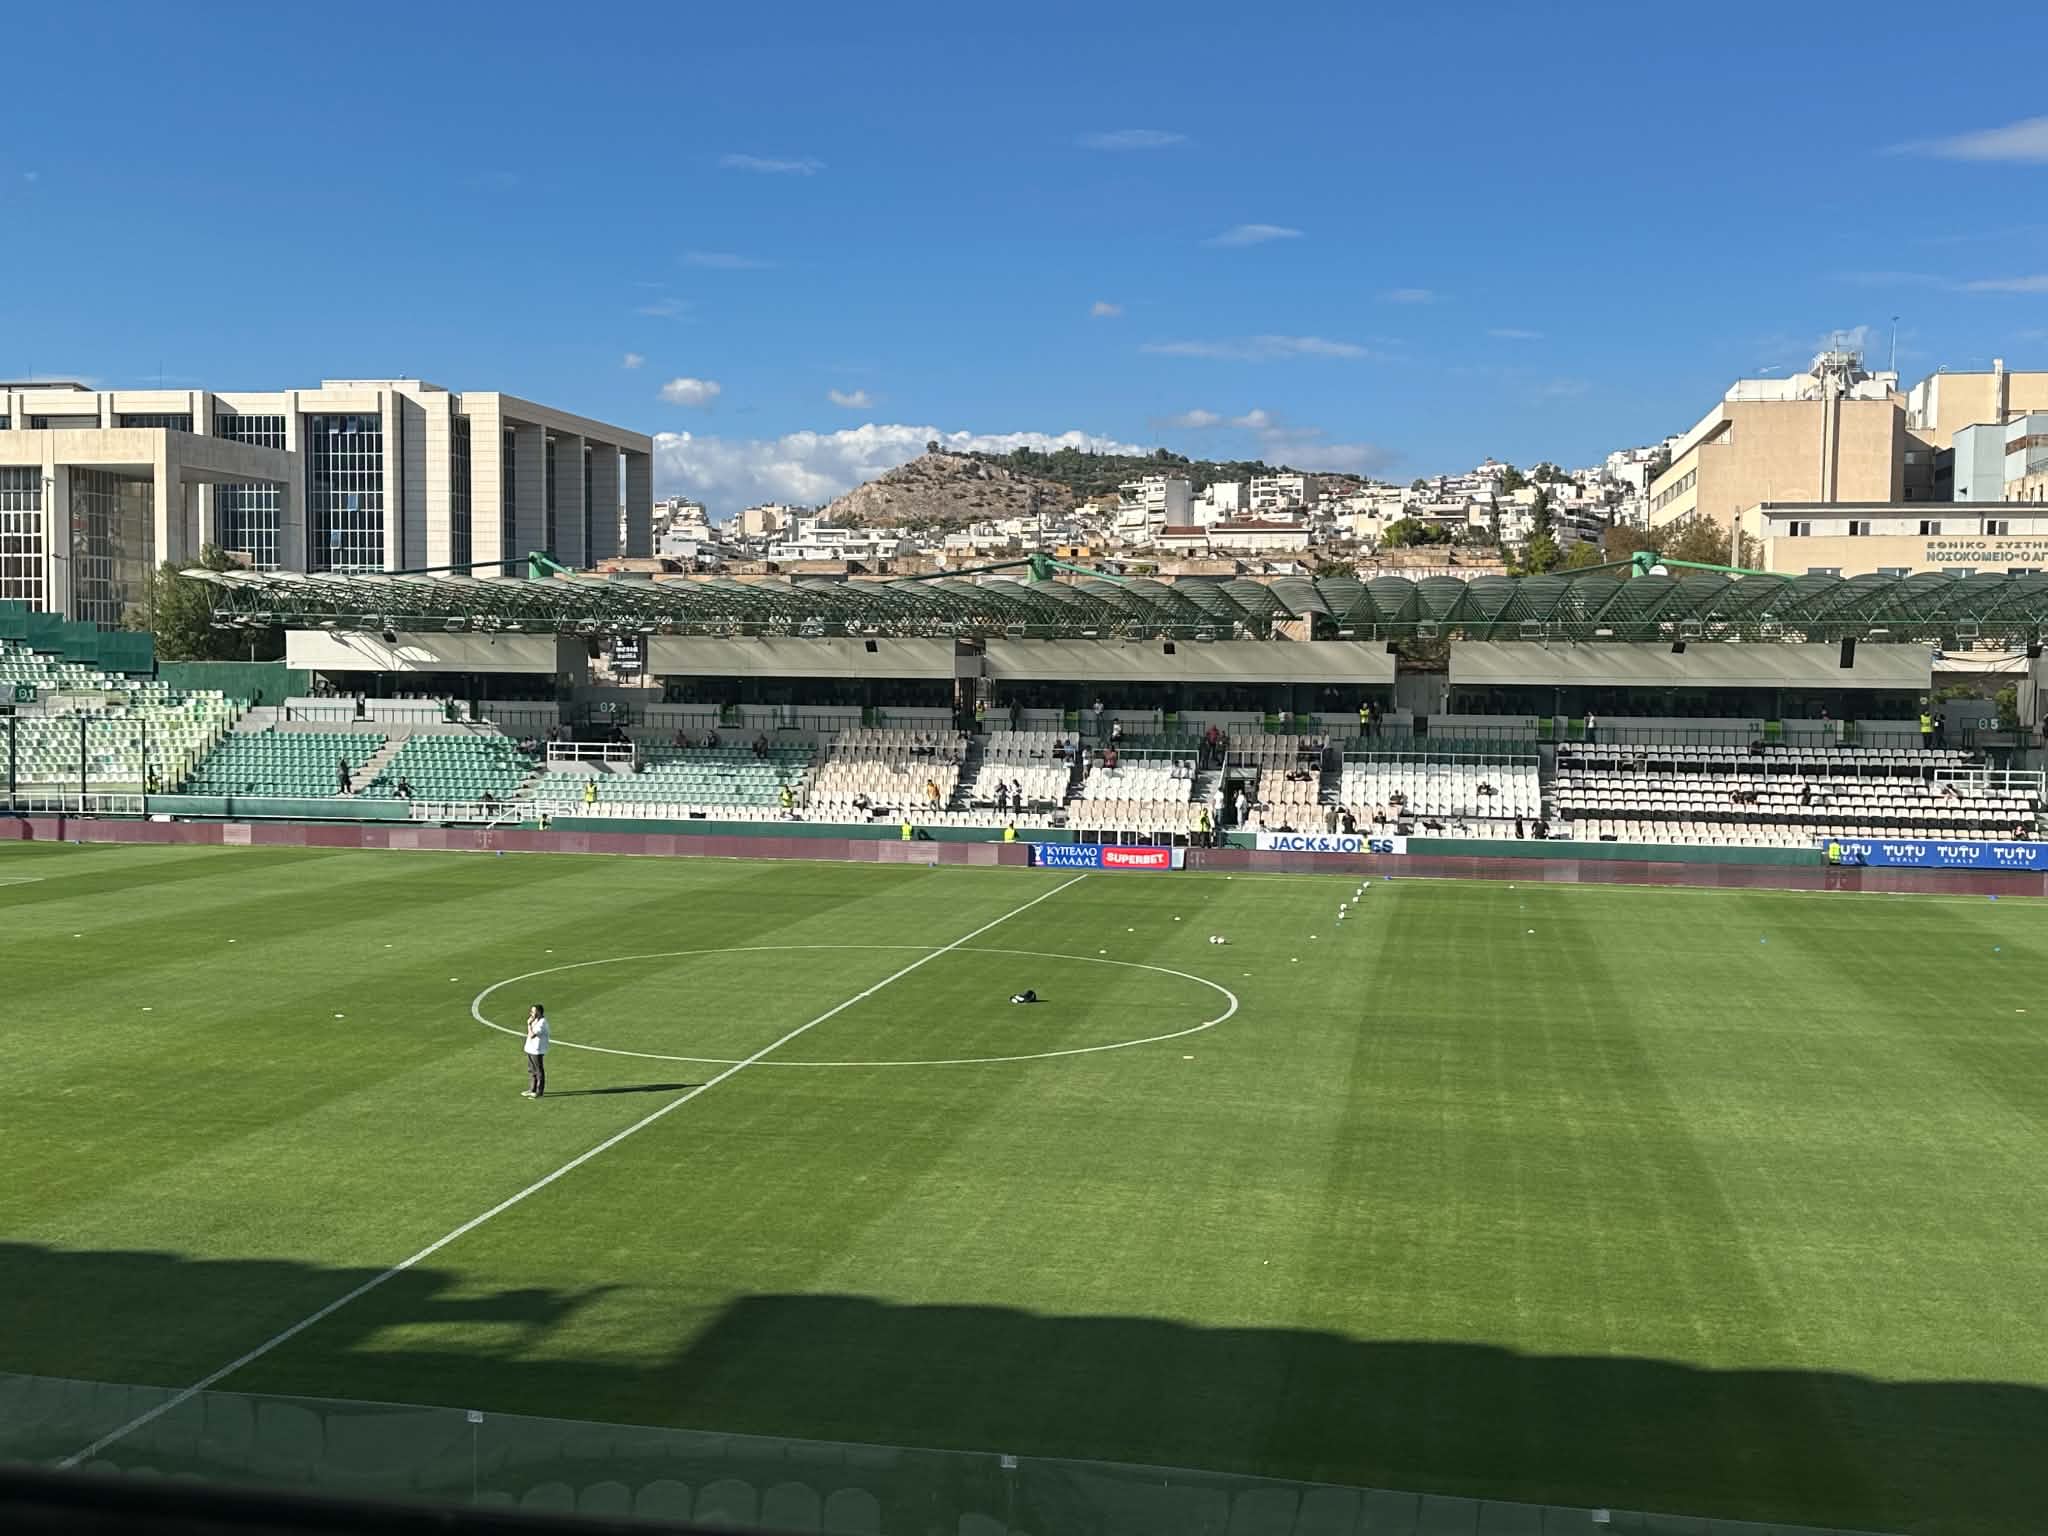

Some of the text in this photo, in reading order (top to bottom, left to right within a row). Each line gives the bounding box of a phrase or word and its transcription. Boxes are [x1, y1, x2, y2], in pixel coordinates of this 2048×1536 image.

[600, 702, 616, 713] 02
[1979, 718, 1999, 730] 05
[1047, 846, 1097, 856] ΚΥΠΕΛΛΟ
[1839, 843, 1872, 856] UTU
[1883, 844, 1926, 857] TUTU
[1937, 845, 1980, 857] TUTU
[1994, 847, 2037, 860] TUTU
[1047, 856, 1097, 865] ΕΛΛΑΔΑΣ
[1106, 852, 1164, 864] SUPERBET
